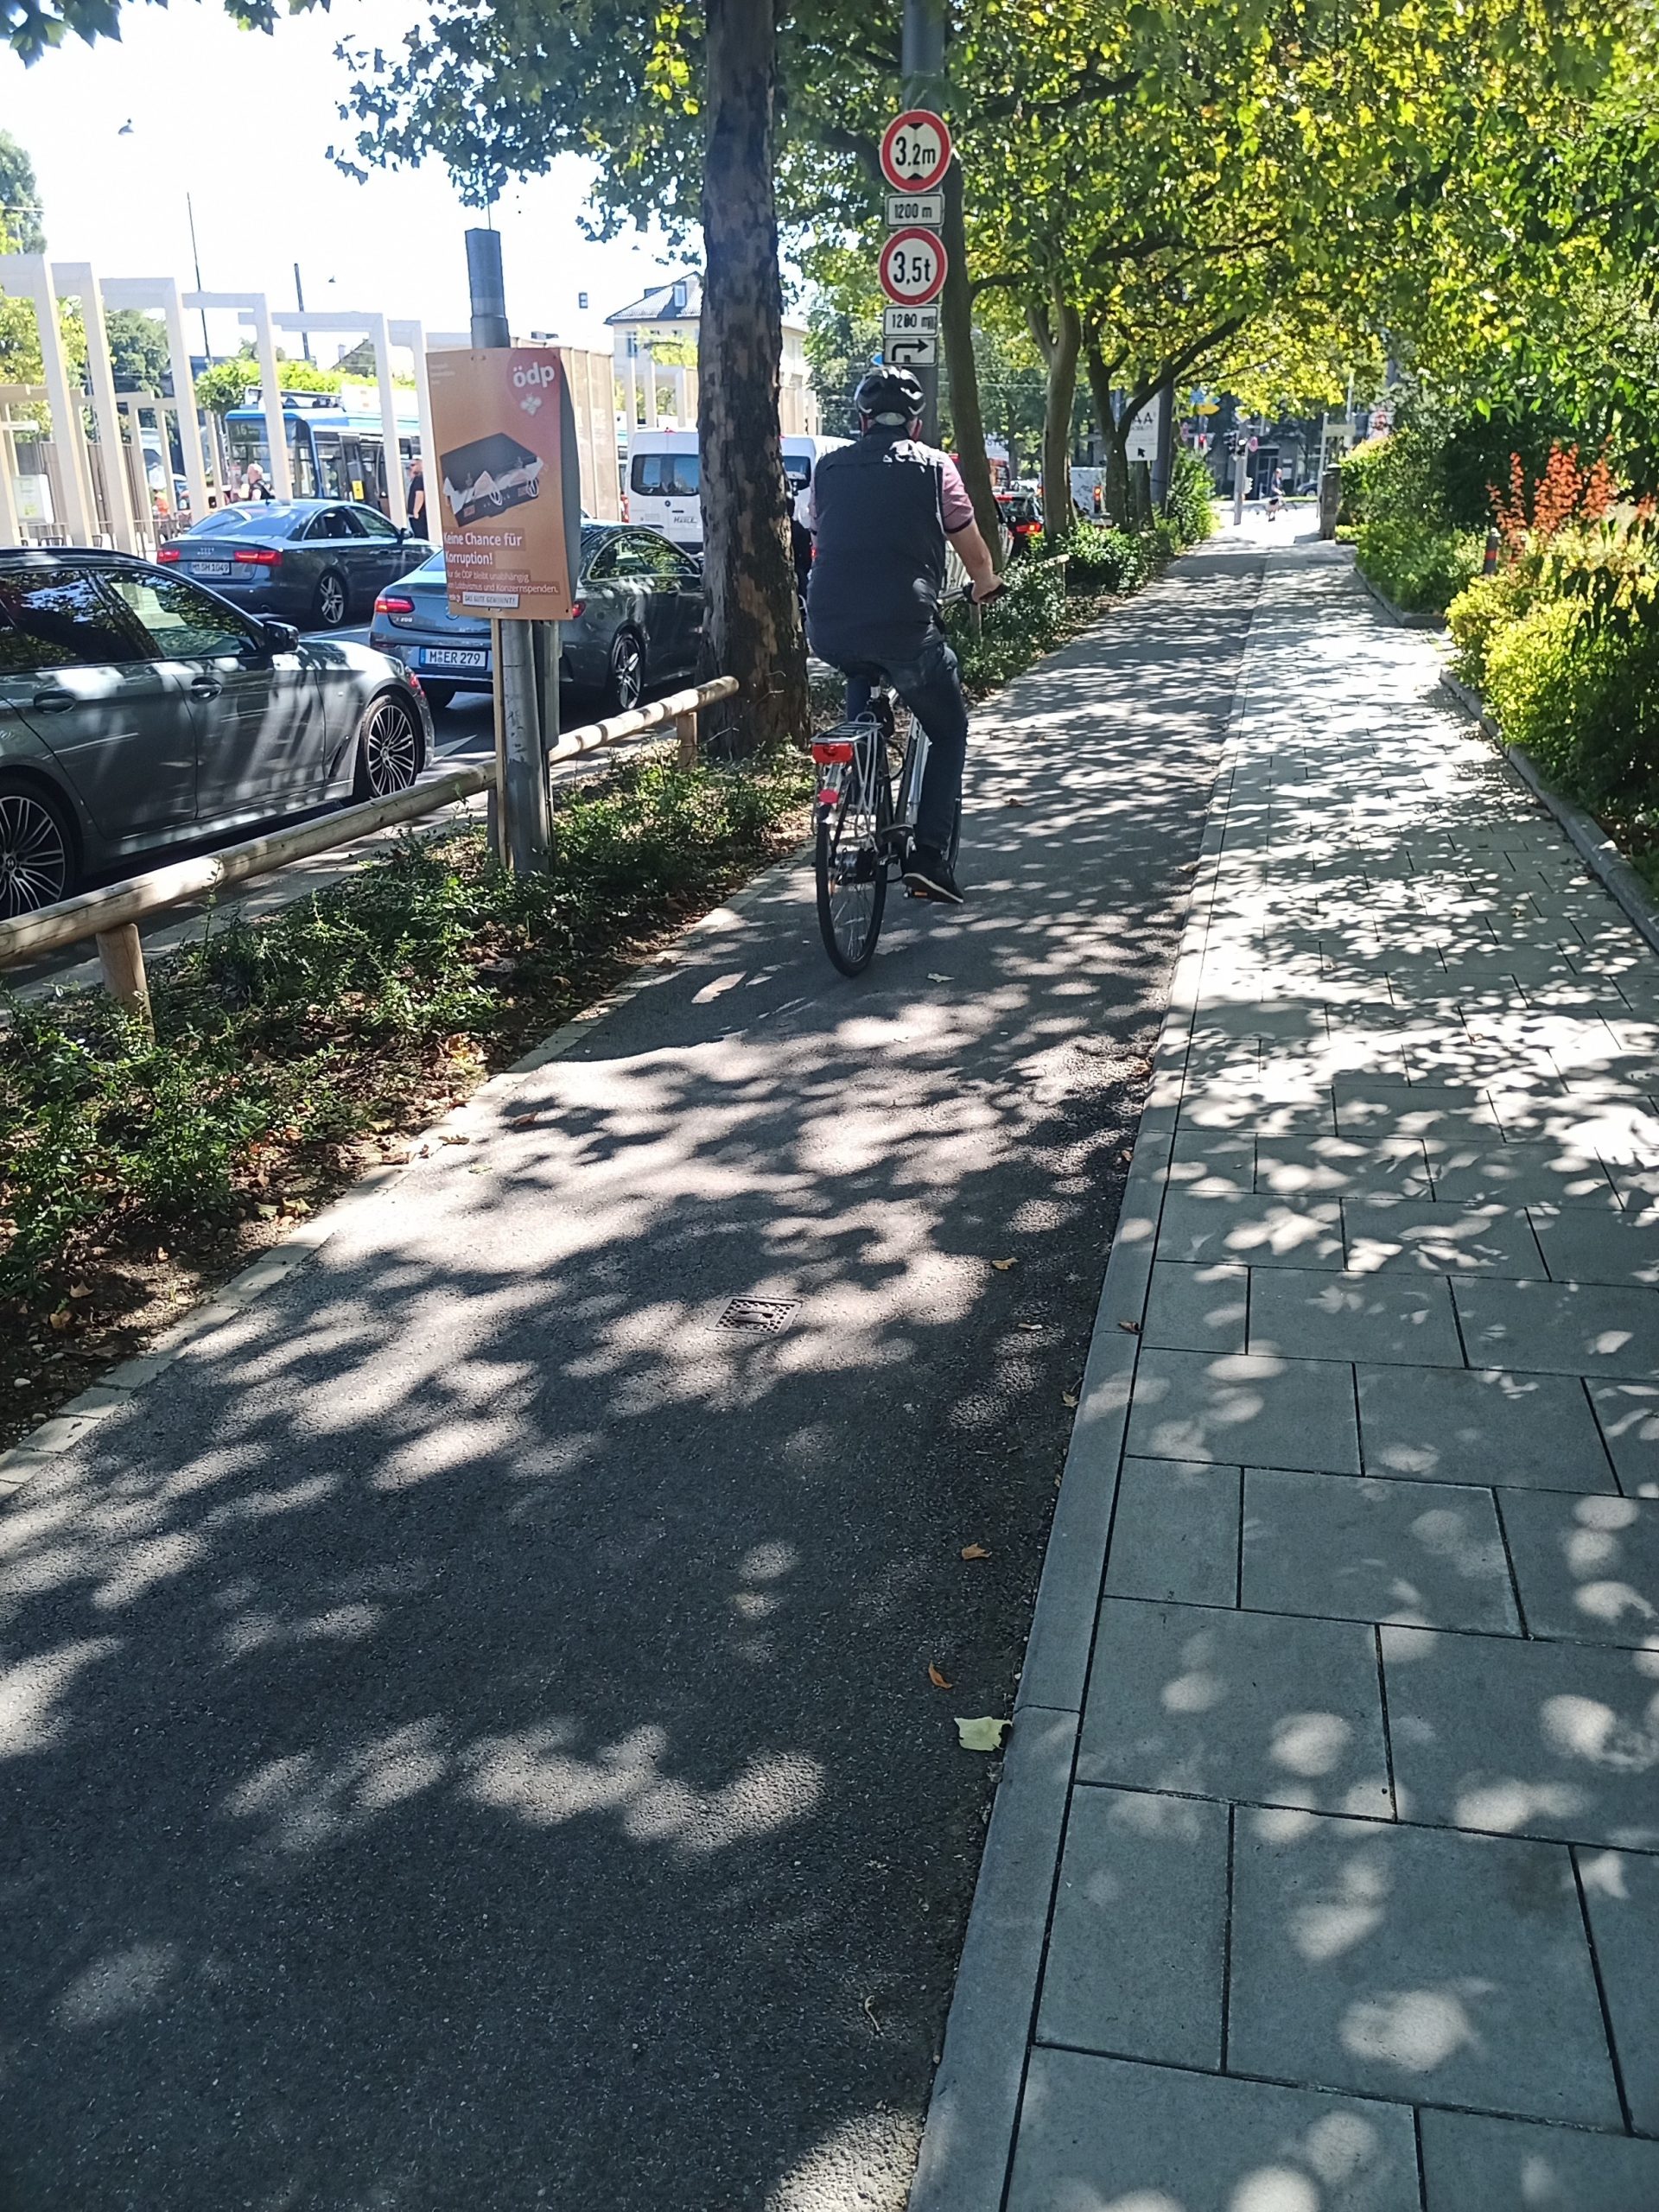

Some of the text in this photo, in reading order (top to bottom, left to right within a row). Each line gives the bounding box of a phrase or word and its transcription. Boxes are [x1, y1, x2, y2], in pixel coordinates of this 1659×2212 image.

[894, 203, 932, 219] 1200 m
[893, 251, 931, 285] 3,5t
[512, 361, 556, 388] ödp
[465, 532, 501, 546] Chance
[504, 532, 523, 546] für
[445, 551, 493, 567] Korruption!
[429, 651, 480, 664] M ER 279
